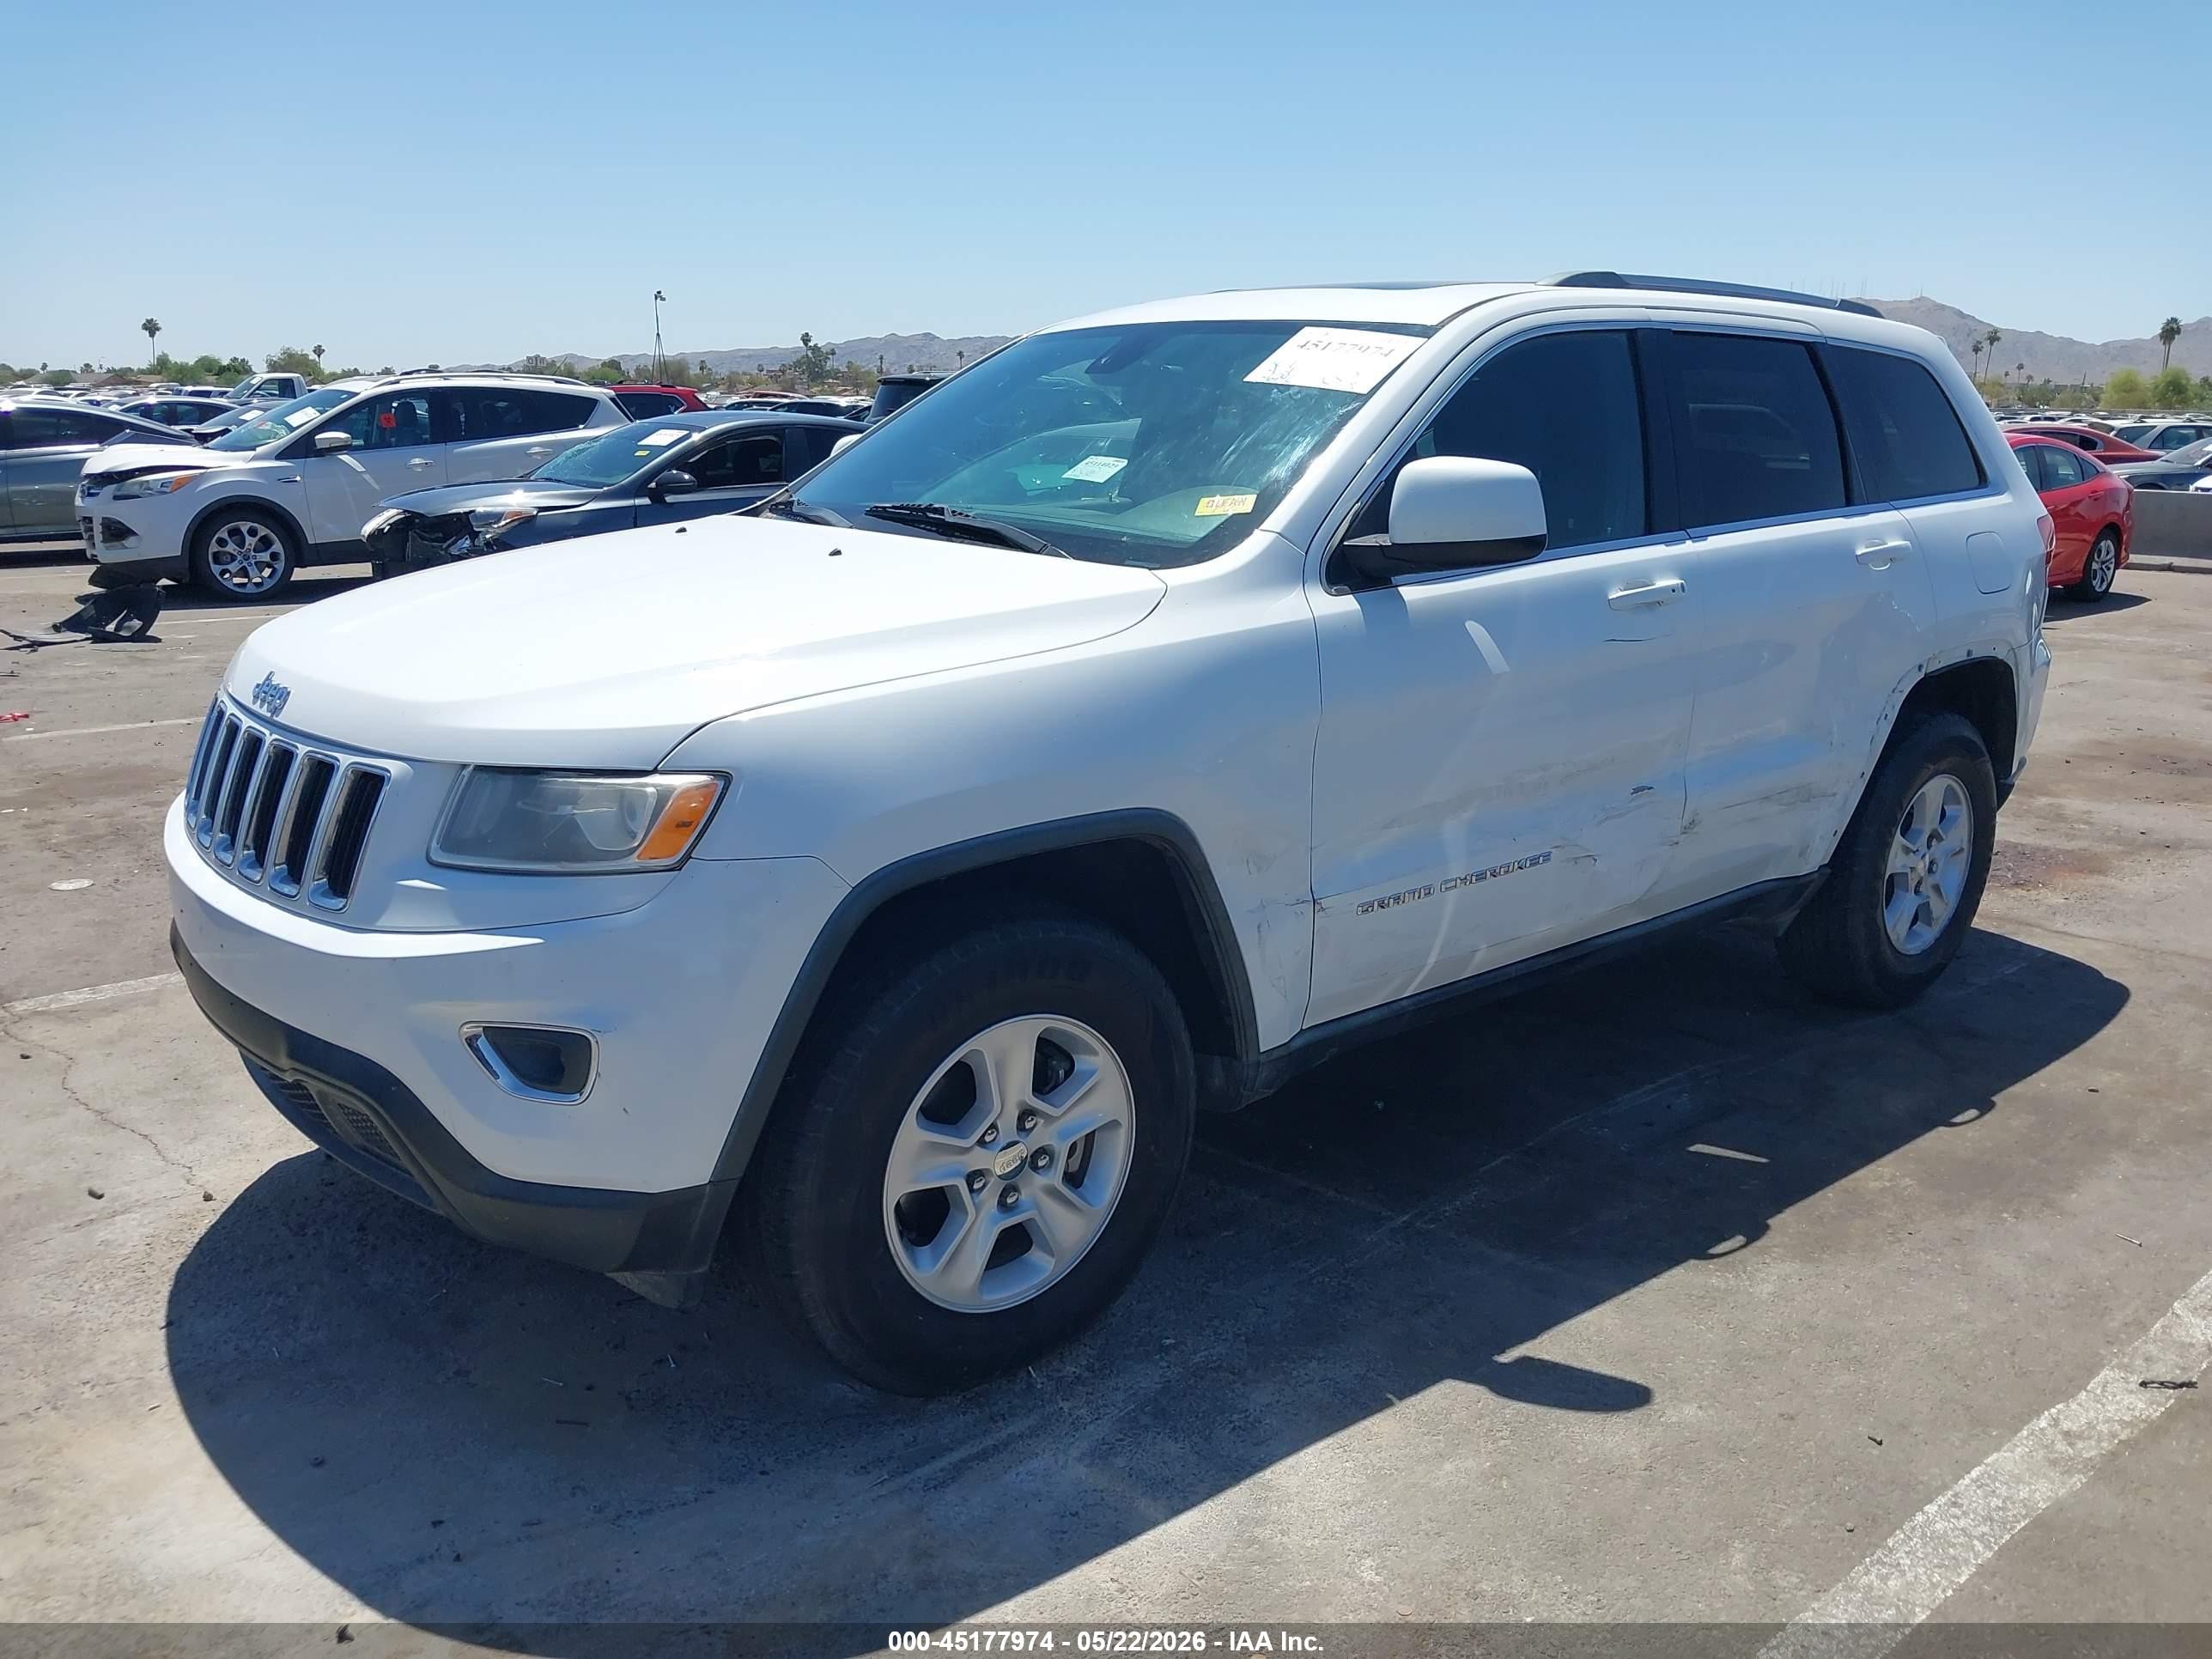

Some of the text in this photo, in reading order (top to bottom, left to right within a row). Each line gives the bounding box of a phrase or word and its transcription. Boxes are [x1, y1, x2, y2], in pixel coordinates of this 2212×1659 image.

[252, 671, 291, 719] Jeep
[1356, 851, 1553, 916] GRAND CHEROKEE
